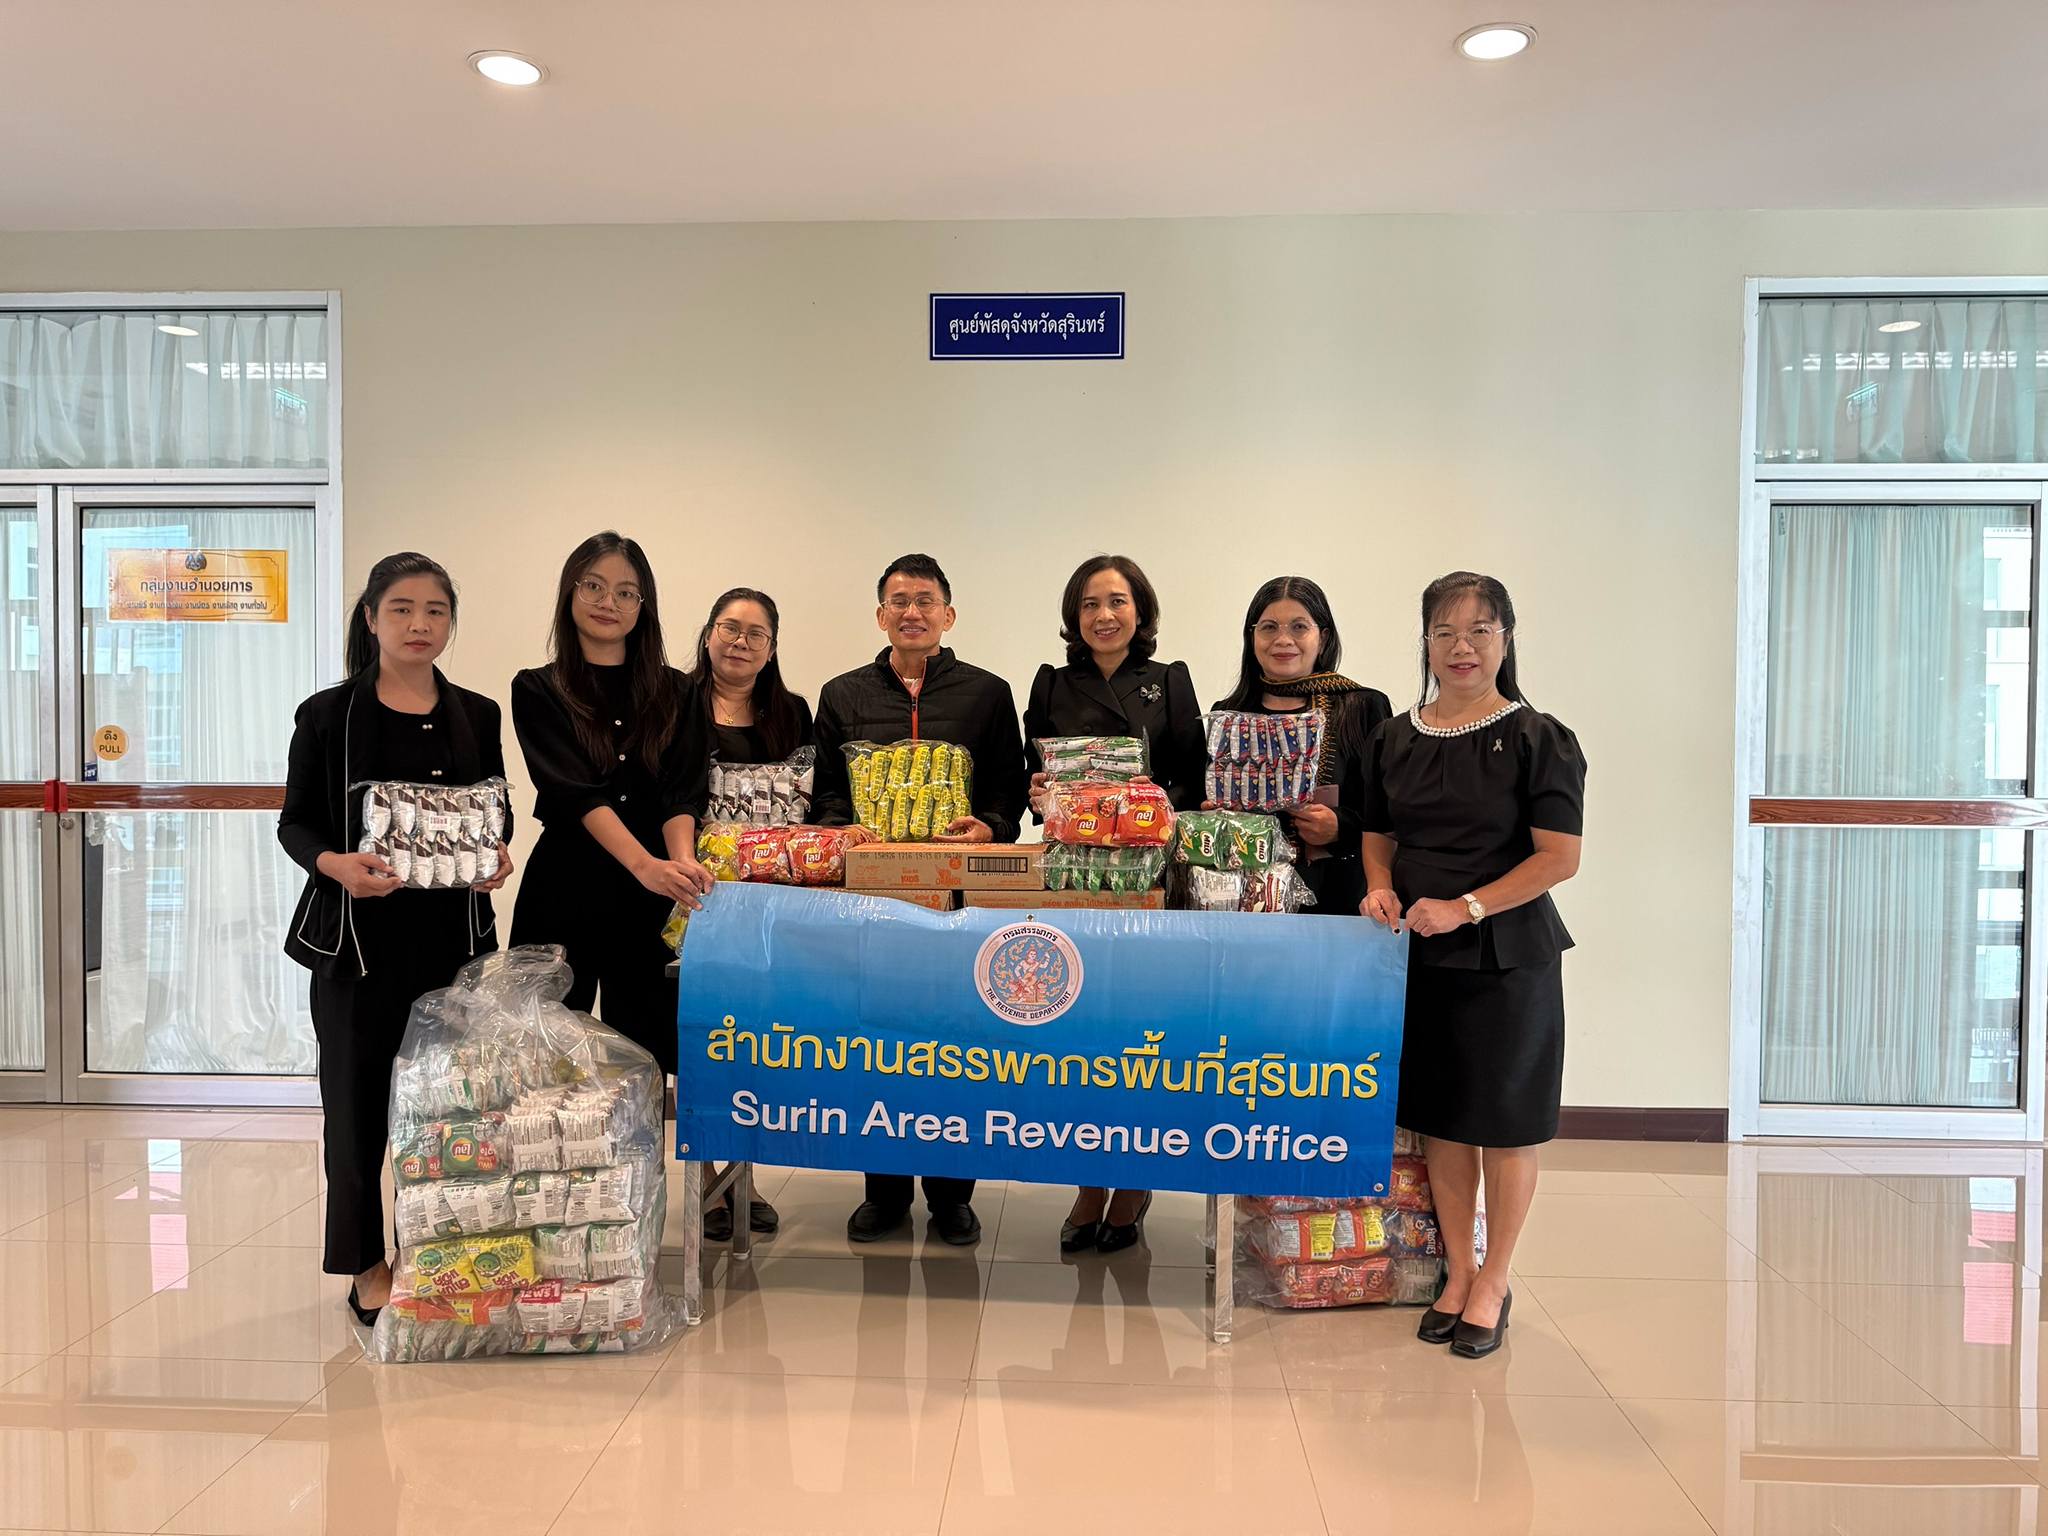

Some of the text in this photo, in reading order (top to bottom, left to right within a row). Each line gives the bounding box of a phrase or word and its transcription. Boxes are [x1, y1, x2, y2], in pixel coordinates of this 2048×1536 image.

[949, 311, 1106, 341] ศูนย์พัสดุจังหวัดสุรินทร์
[140, 576, 253, 595] กลุ่มงานอำนวยการ
[99, 744, 122, 754] PULL
[1203, 834, 1211, 854] MILO
[1002, 927, 1058, 942] กรมสรรพากร
[985, 987, 1072, 1020] THE REVENUE DEPARTMENT
[706, 1014, 1382, 1112] สำนักงานสรรพากรพื้นที่สุรินทร์
[731, 1090, 1349, 1163] Surin Area Revenue Office
